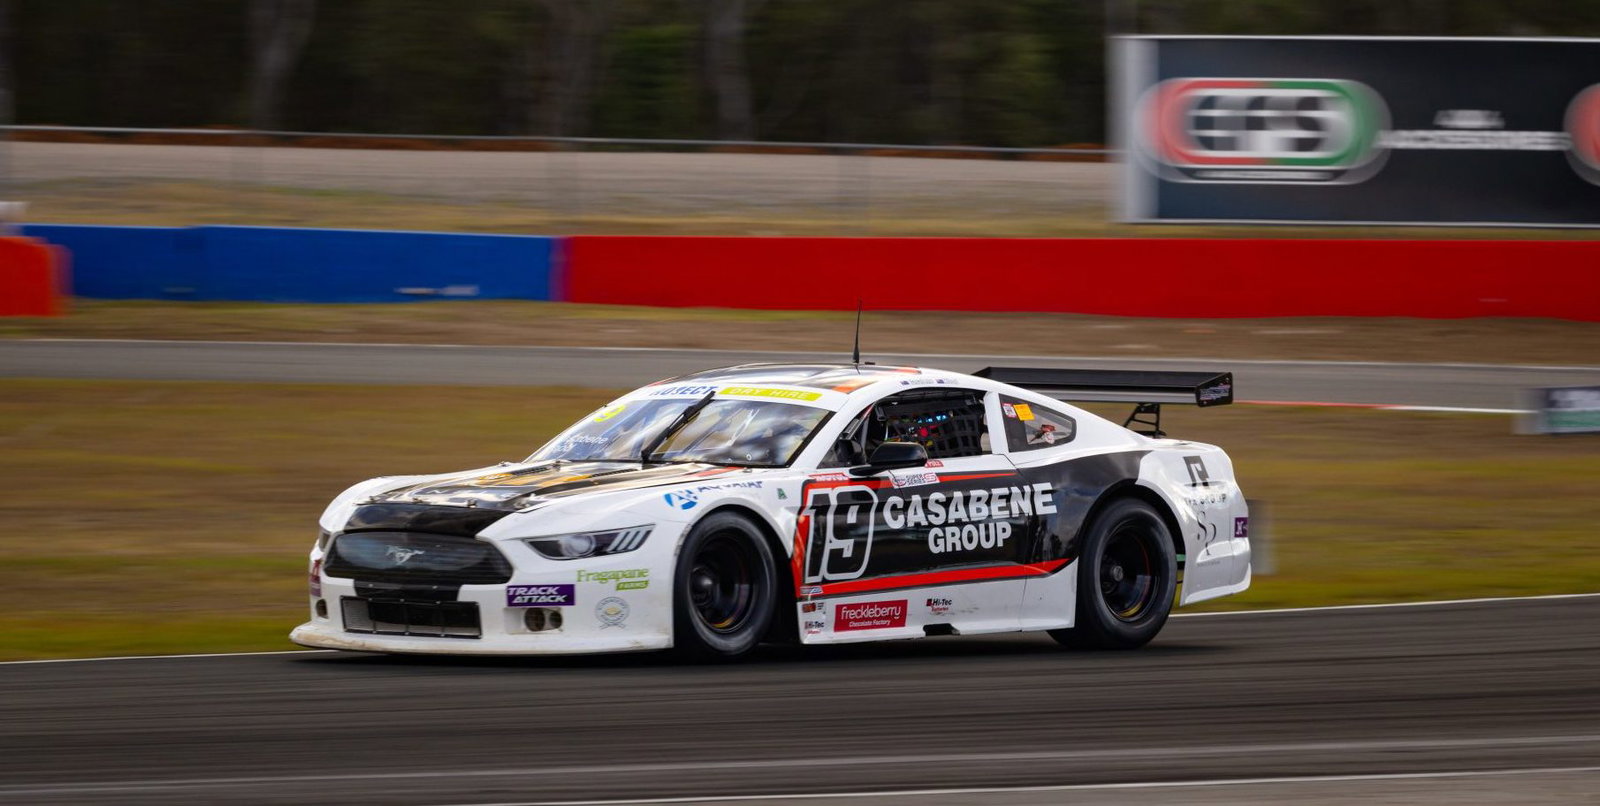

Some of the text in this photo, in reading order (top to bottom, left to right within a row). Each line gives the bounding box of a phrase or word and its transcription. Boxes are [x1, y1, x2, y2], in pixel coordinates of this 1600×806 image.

[732, 388, 810, 400] DRY HIRE
[883, 482, 1058, 529] CASABENE
[803, 485, 879, 583] 19
[928, 521, 1012, 554] GROUP
[577, 569, 649, 584] Fragapane
[507, 587, 560, 596] TRACK
[512, 594, 567, 603] ATTACK
[932, 598, 952, 606] Hi-Tec
[841, 606, 901, 619] freckleberry
[848, 619, 891, 628] Chocolate Factory
